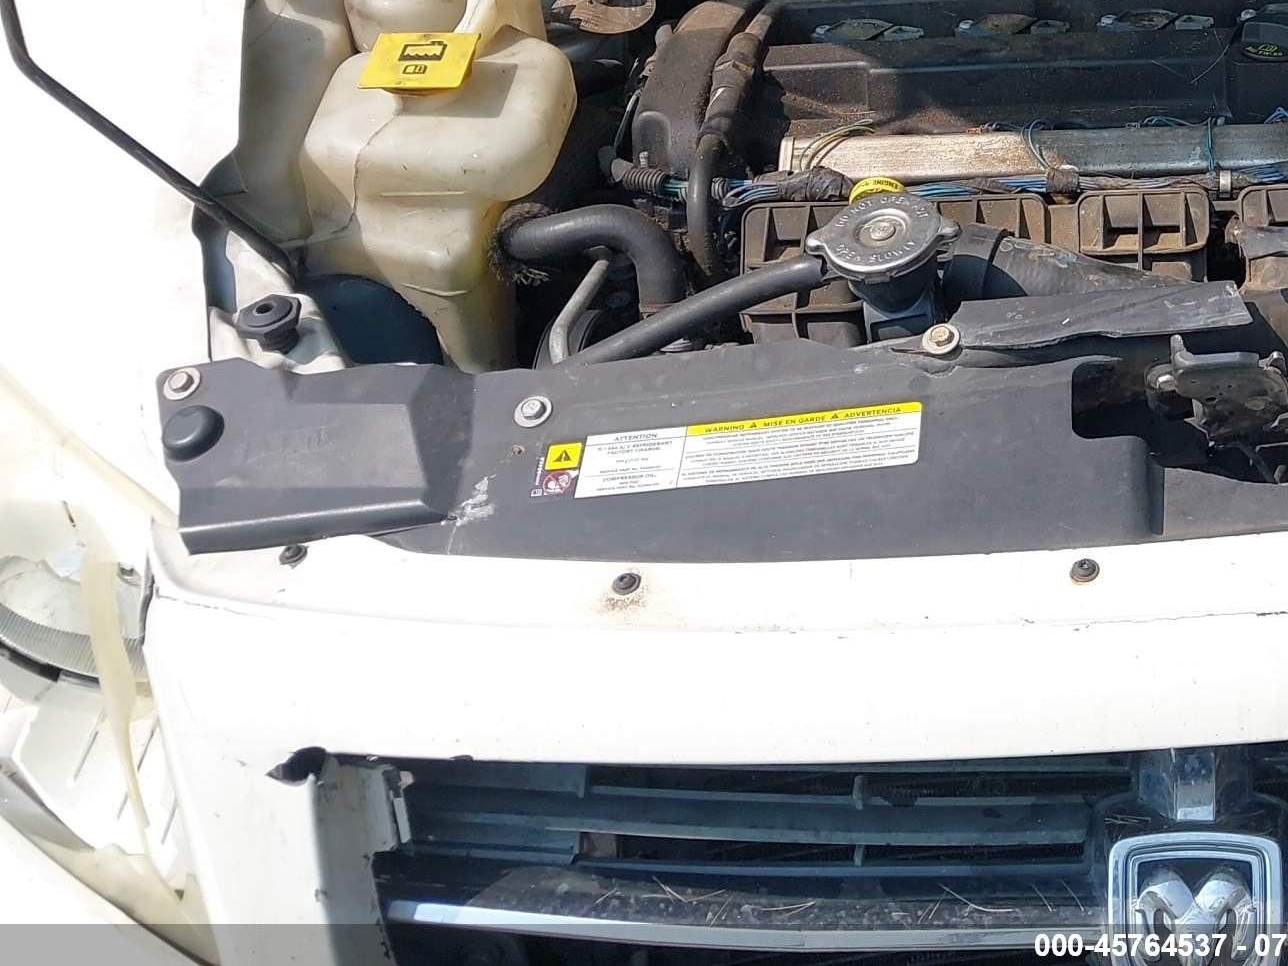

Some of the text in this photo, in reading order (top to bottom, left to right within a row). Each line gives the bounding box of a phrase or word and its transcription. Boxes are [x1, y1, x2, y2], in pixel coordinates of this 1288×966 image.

[705, 424, 745, 433] WARNING
[798, 415, 825, 423] GARDE
[844, 407, 902, 417] ADVERTENCIA
[614, 433, 658, 442] ATTENTION
